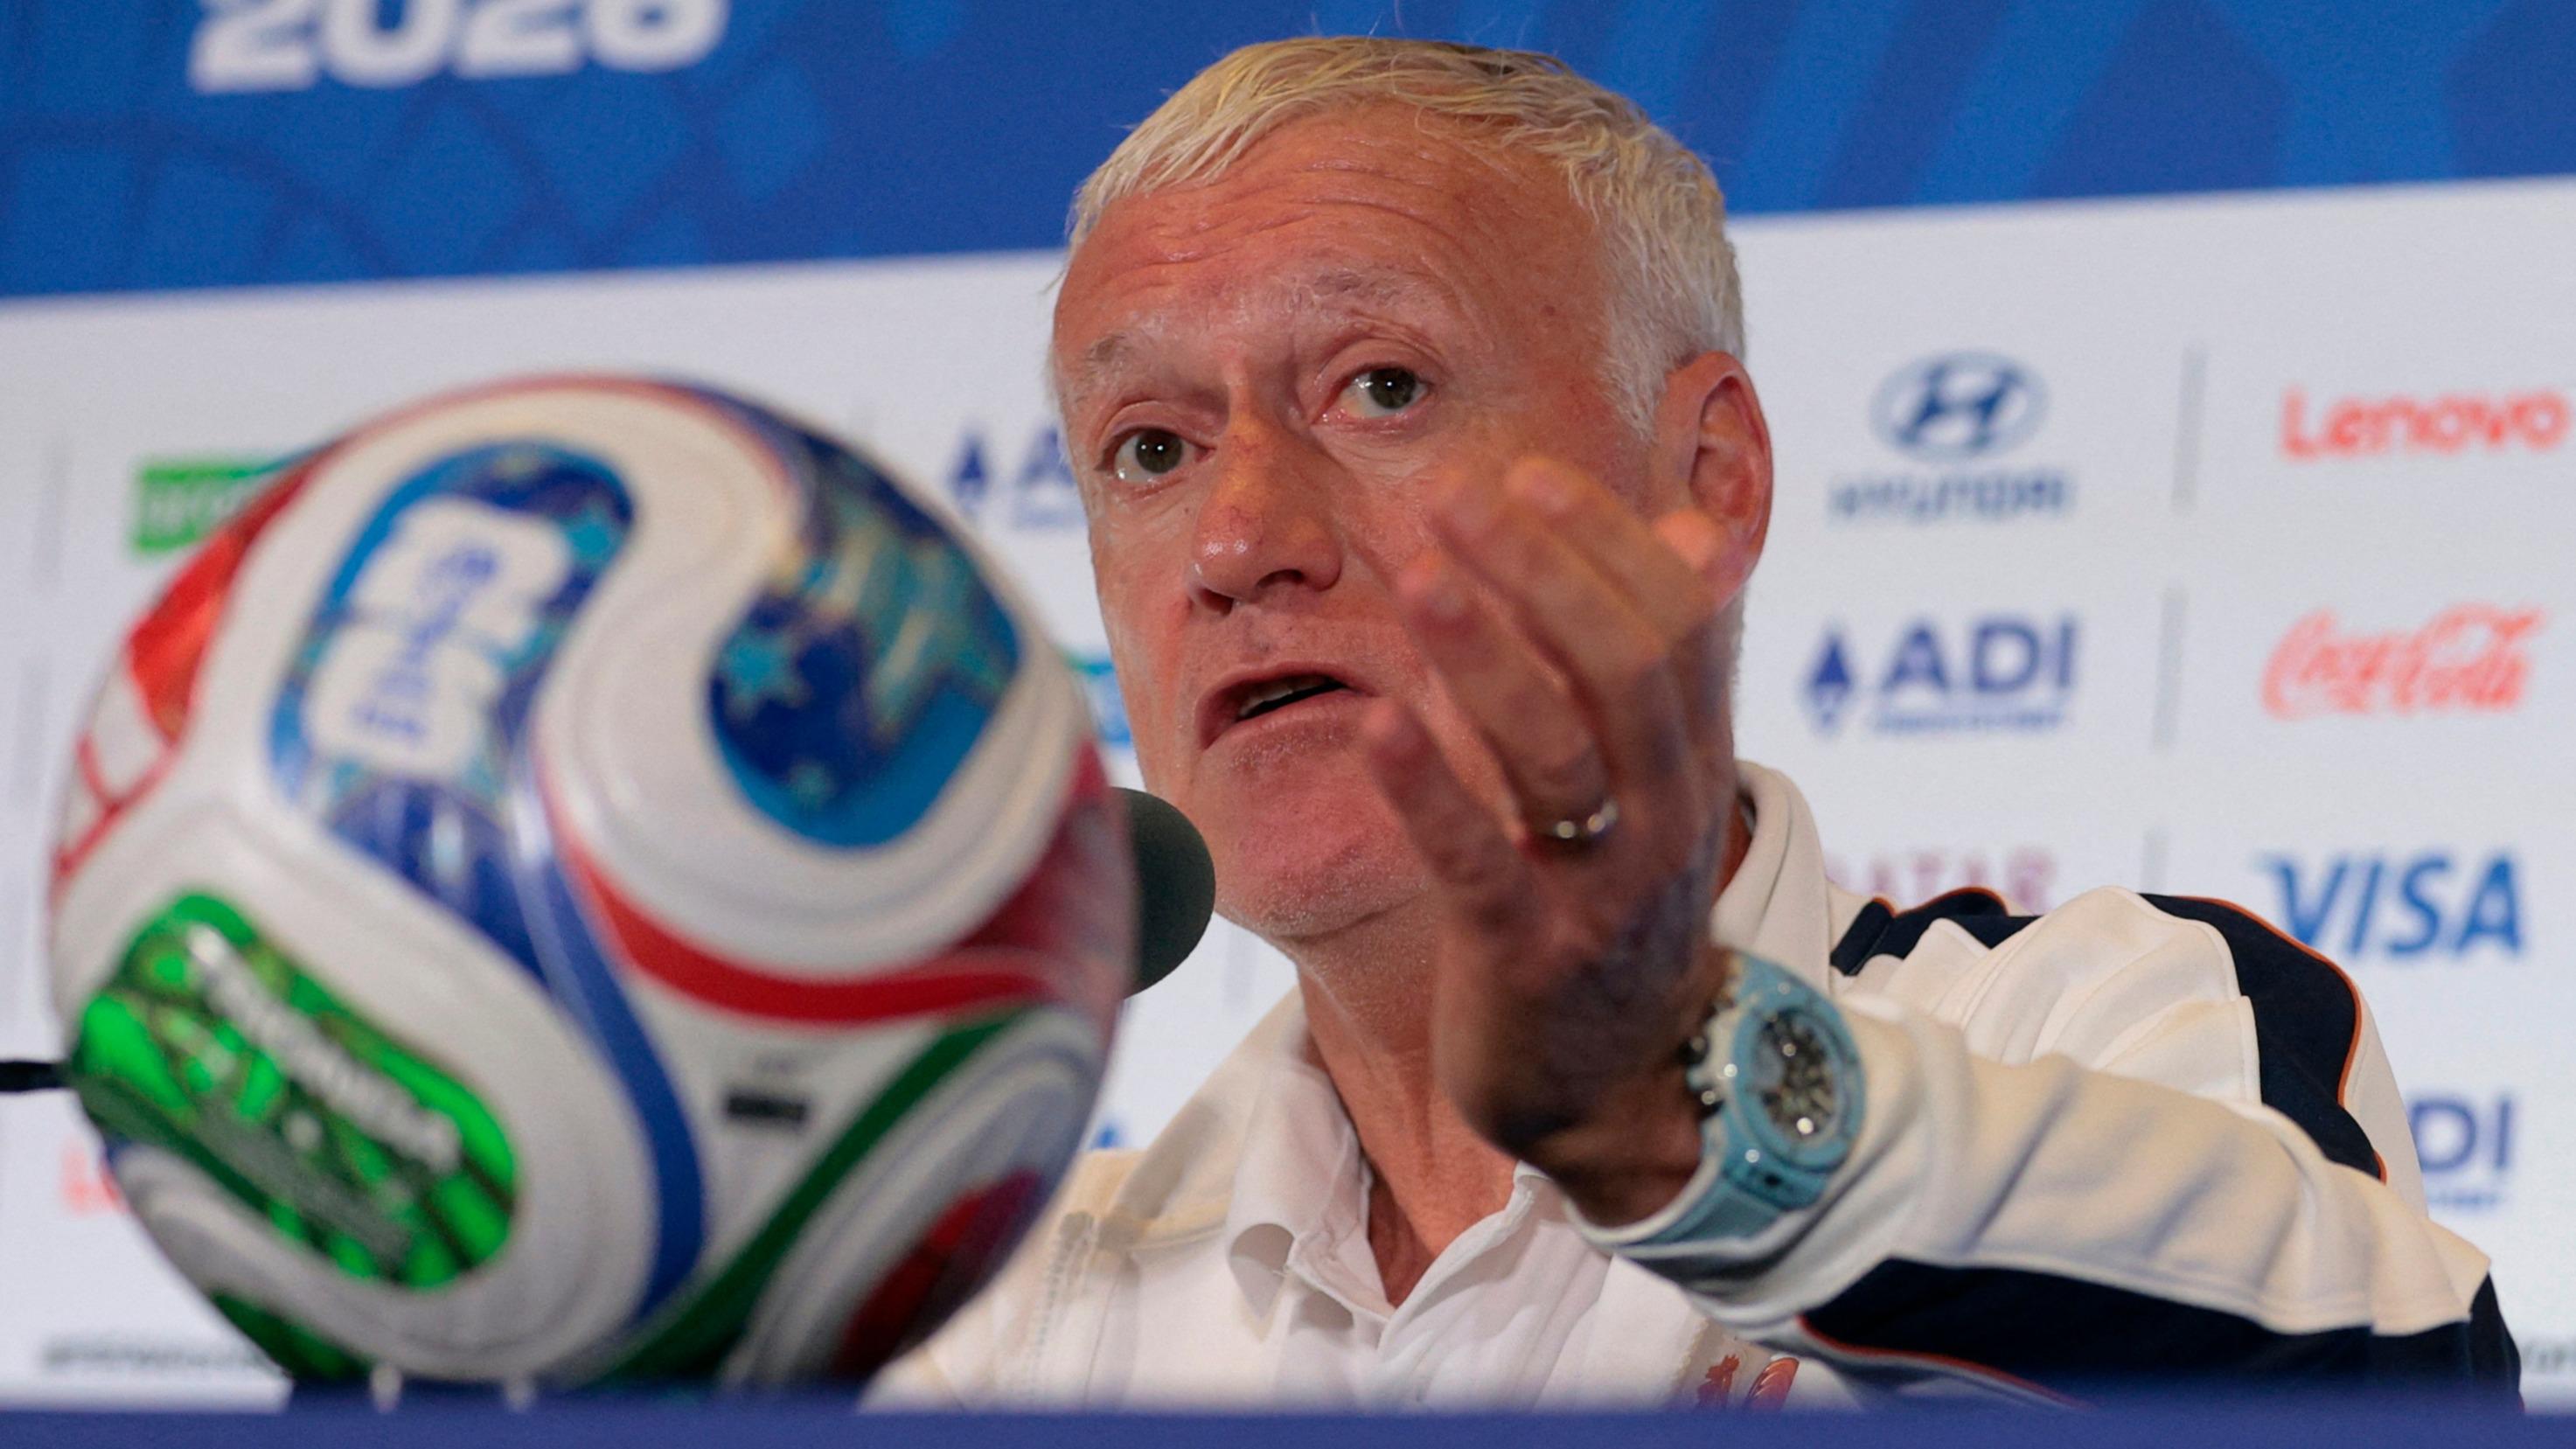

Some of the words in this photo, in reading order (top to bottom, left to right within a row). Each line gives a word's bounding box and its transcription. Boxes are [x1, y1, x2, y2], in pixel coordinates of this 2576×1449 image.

[2281, 386, 2569, 460] Lenovo
[1880, 617, 2076, 693] ADI
[1826, 848, 2055, 915] ATAR
[2258, 850, 2527, 957] VISA
[2409, 1093, 2513, 1173] DI
